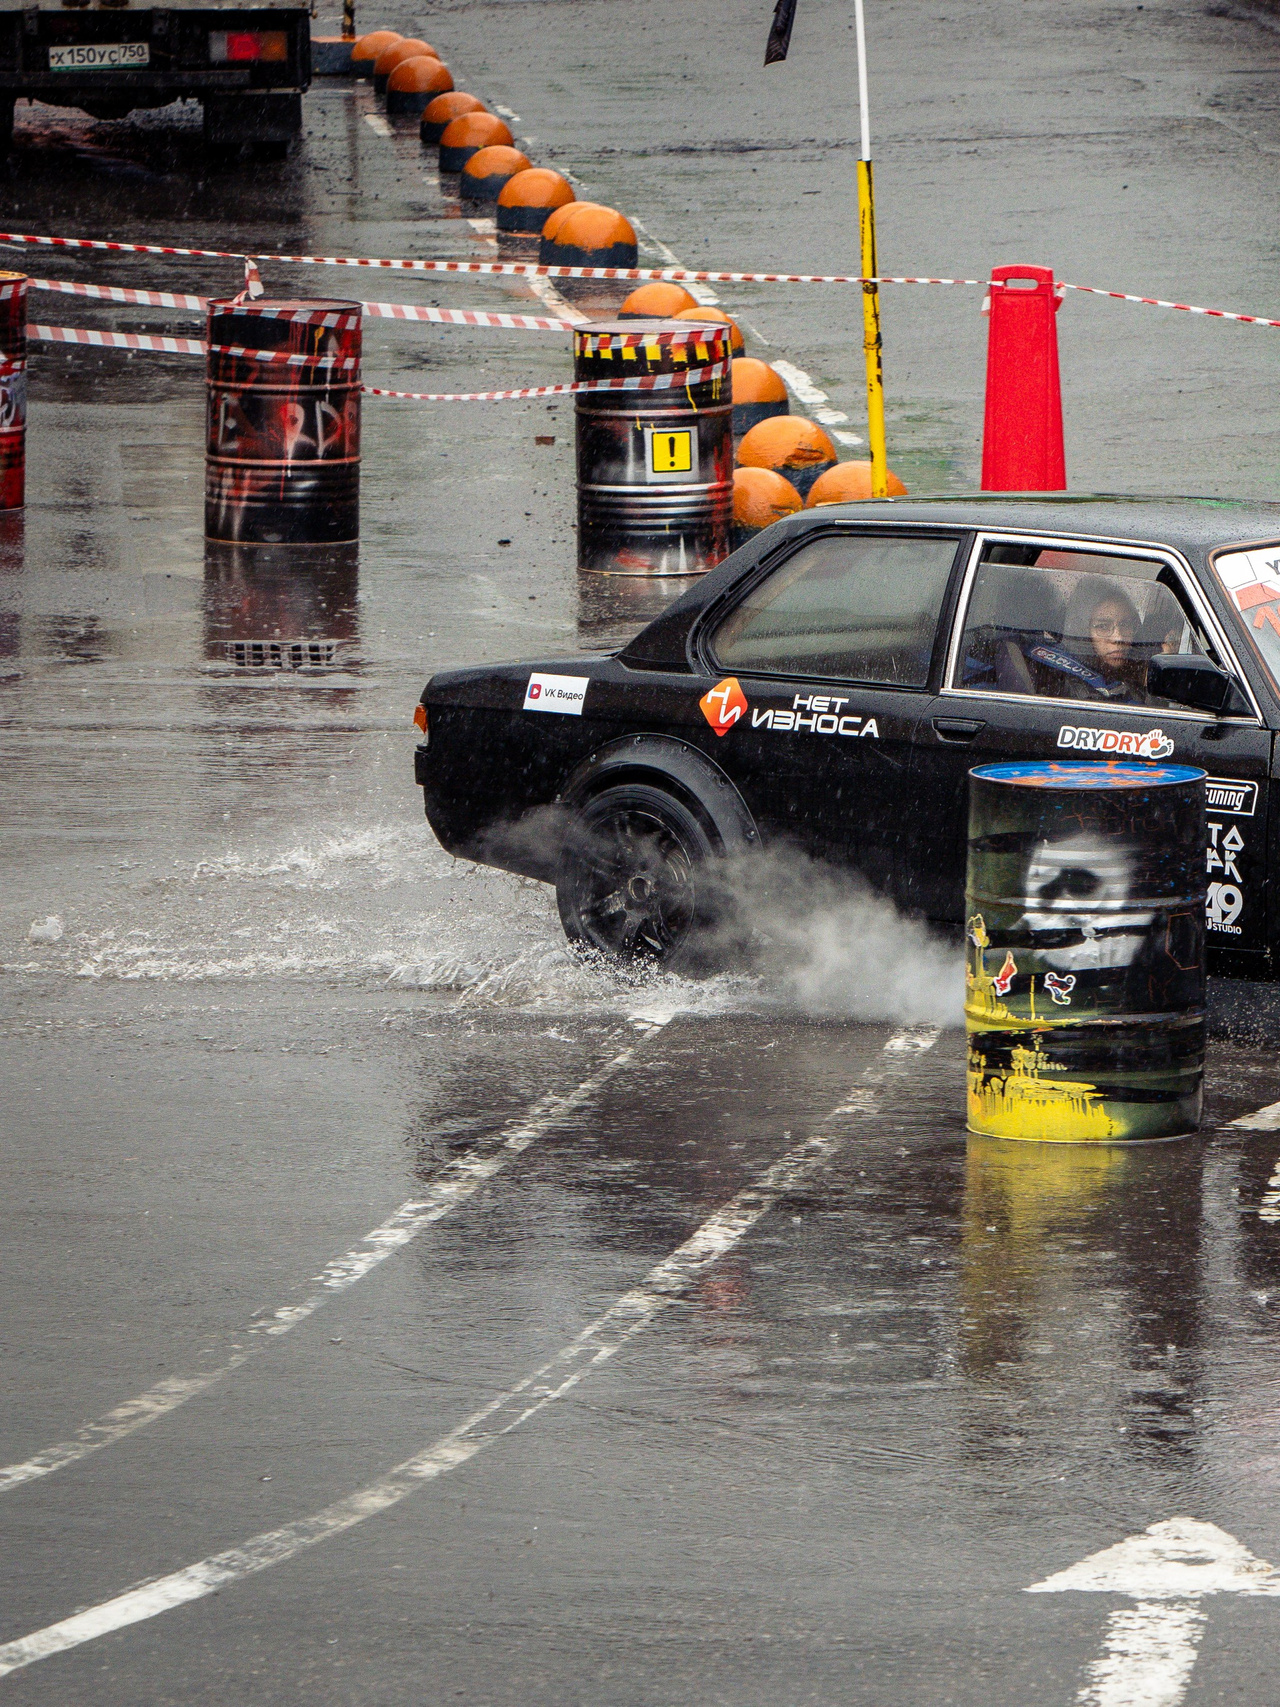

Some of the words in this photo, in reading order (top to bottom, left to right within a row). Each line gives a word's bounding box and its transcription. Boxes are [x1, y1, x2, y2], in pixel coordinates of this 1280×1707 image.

[120, 45, 146, 59] 750
[544, 688, 556, 698] VK
[557, 689, 584, 701] Видео
[793, 694, 850, 713] НЕТ
[751, 708, 880, 739] ИЗНОСА
[1059, 728, 1148, 753] DRYDRY
